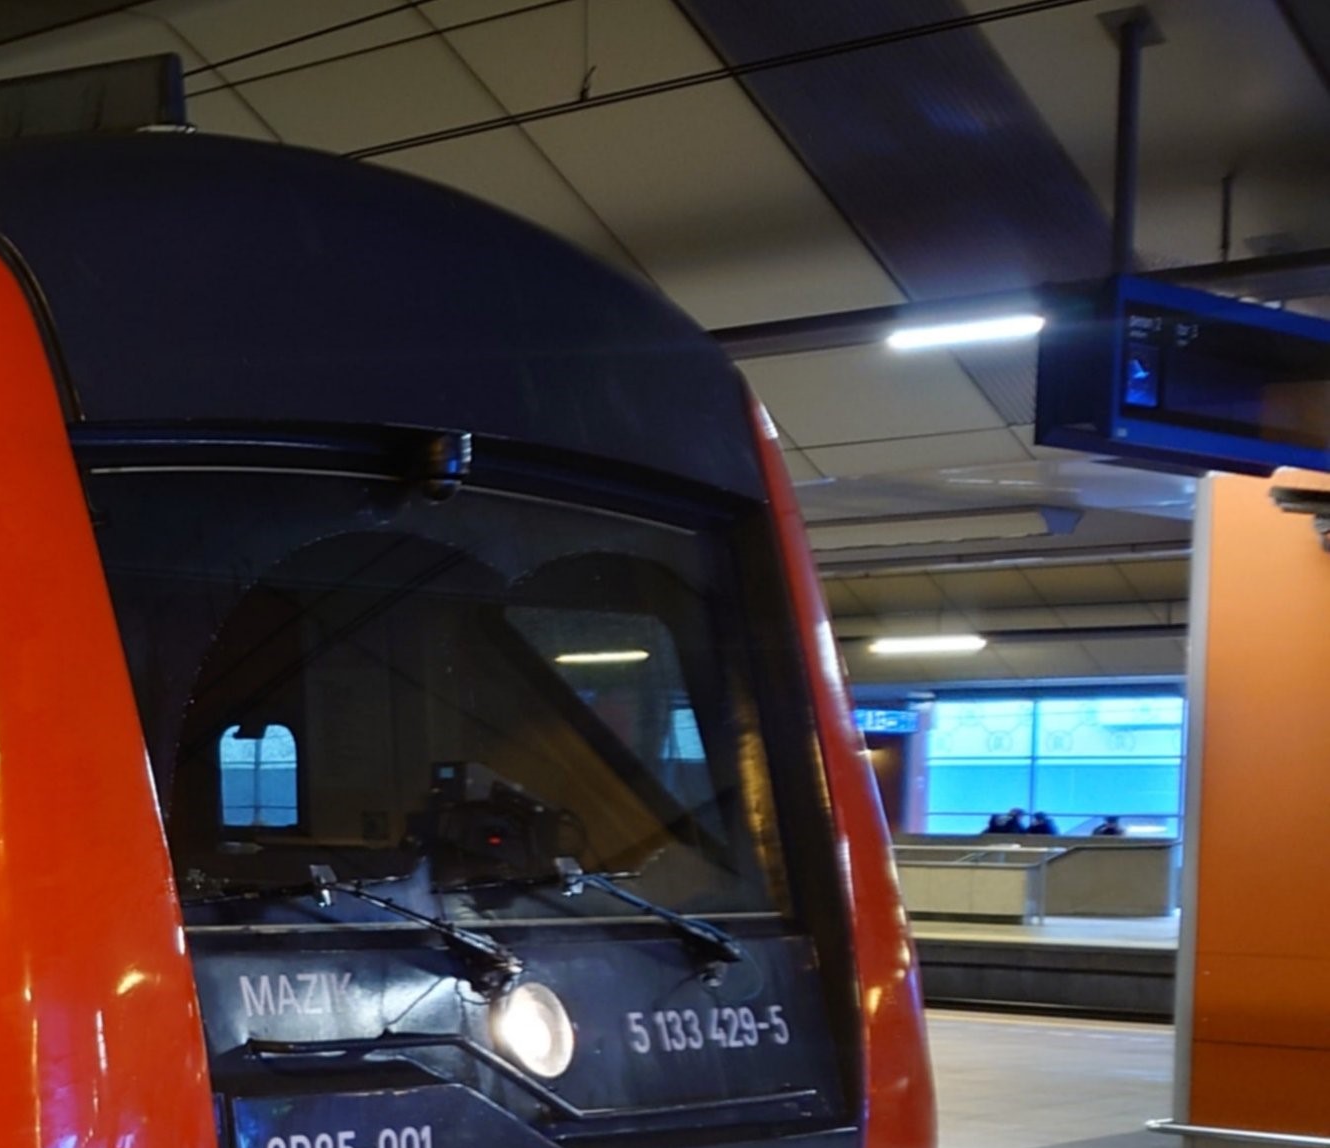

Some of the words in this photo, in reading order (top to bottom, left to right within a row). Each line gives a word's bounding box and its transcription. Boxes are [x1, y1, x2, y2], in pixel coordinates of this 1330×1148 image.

[239, 972, 353, 1017] MAZIK
[627, 1012, 651, 1053] 5
[654, 1009, 704, 1052] 133
[709, 1005, 789, 1048] 429-5
